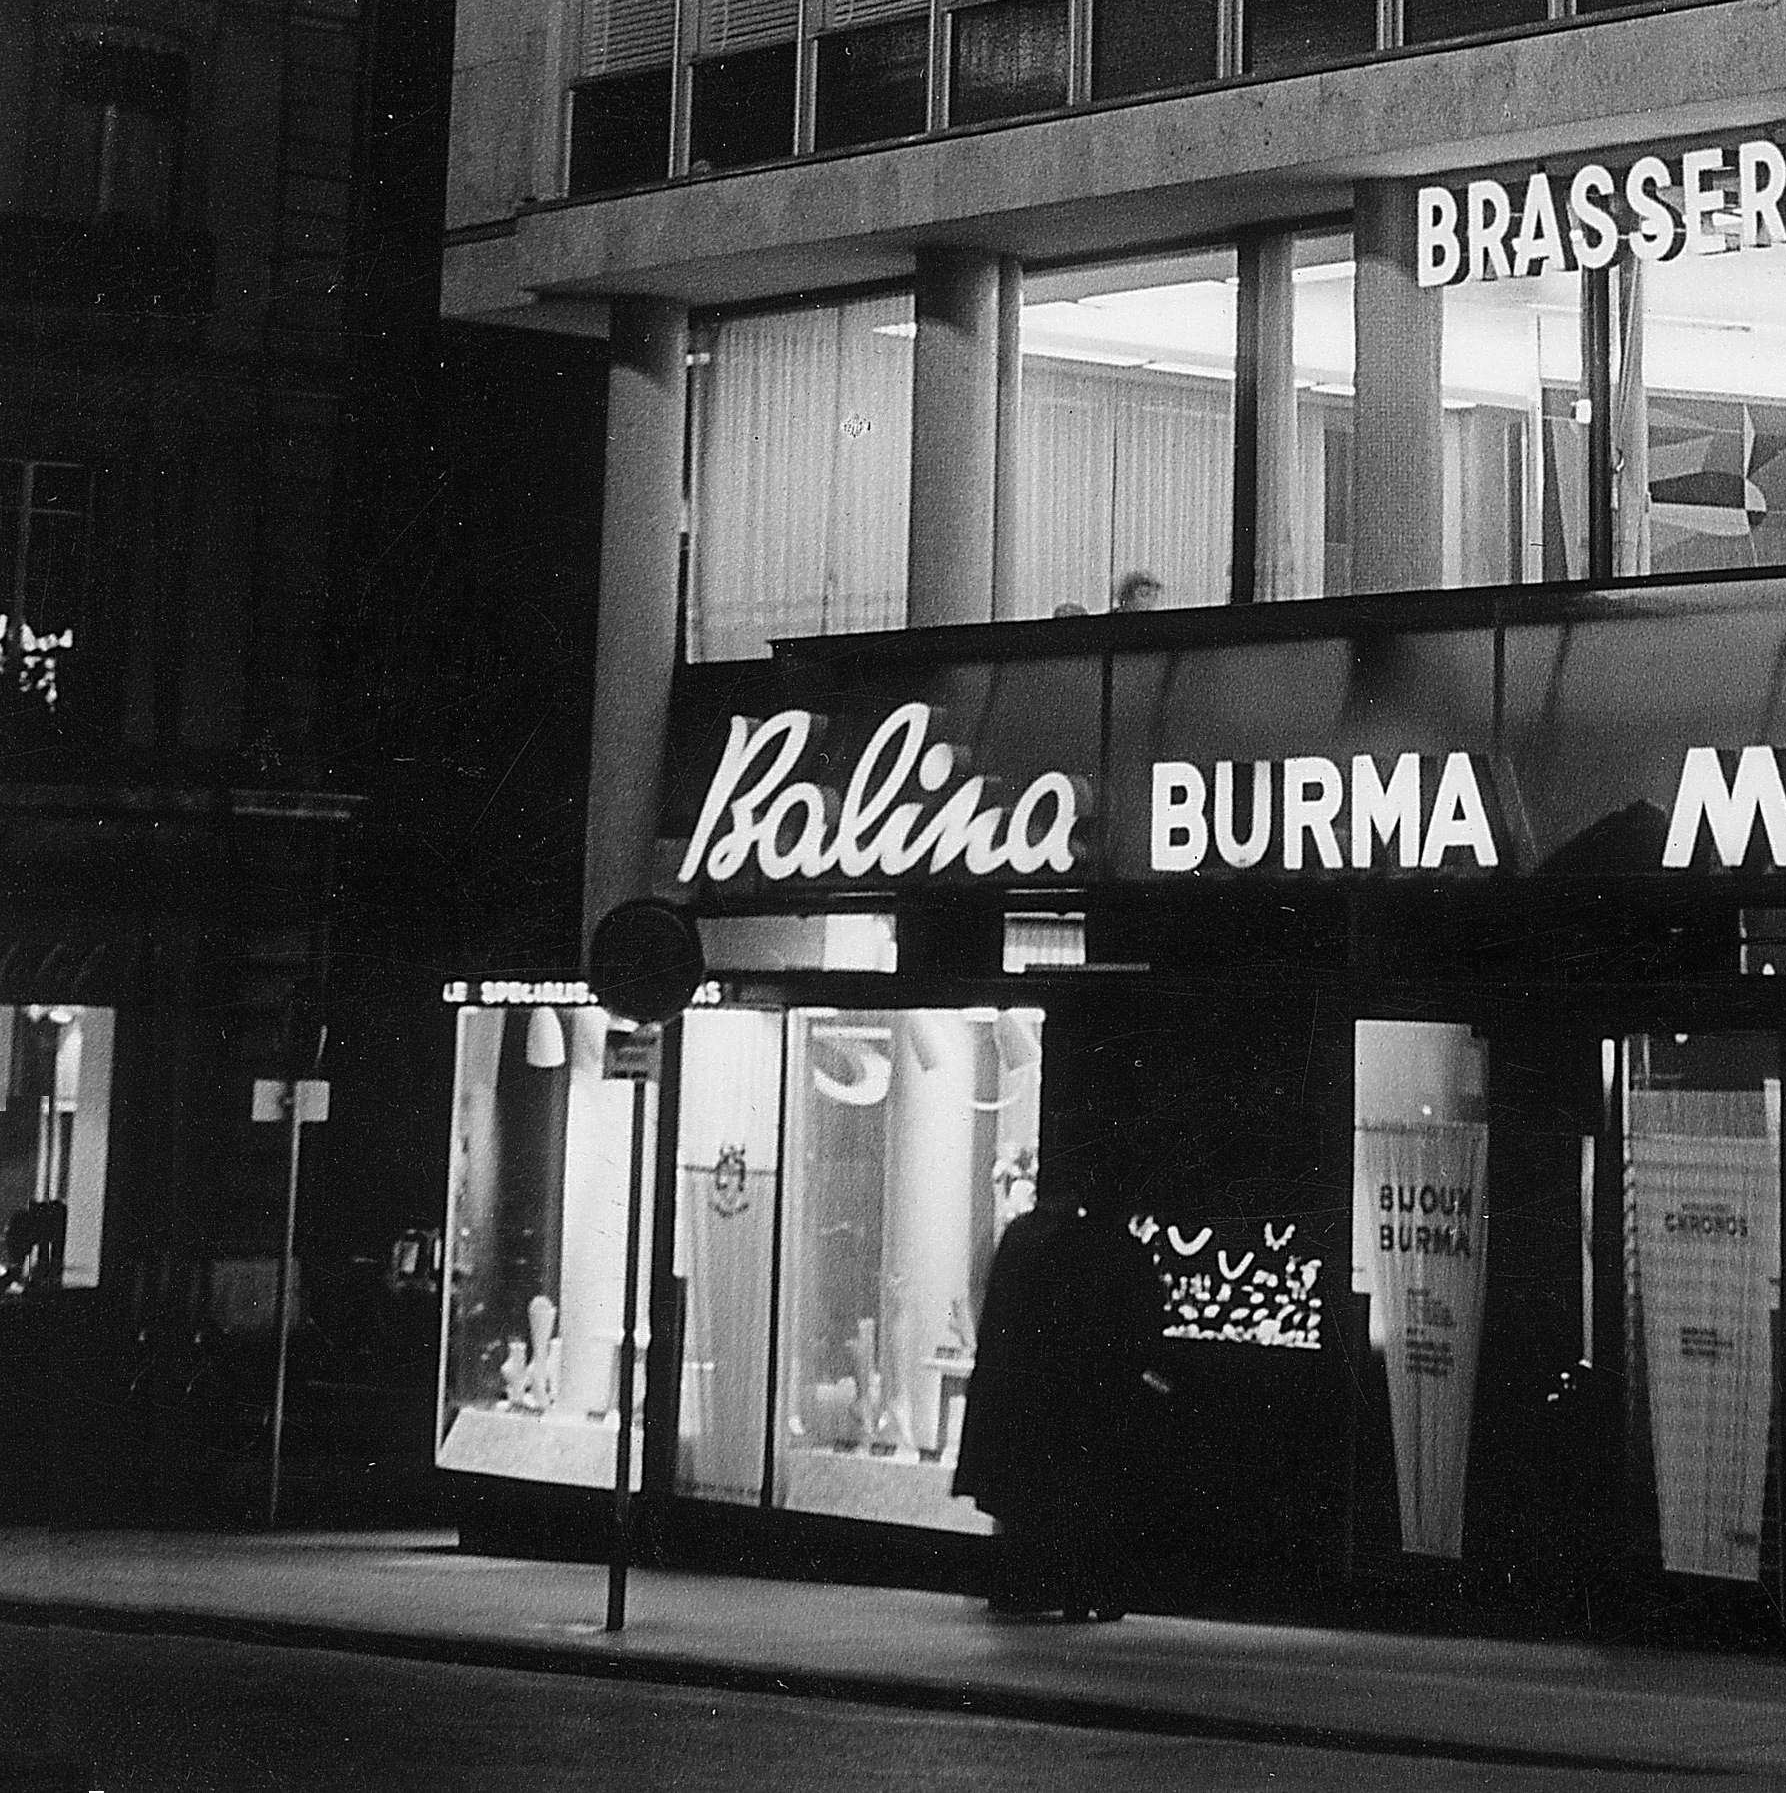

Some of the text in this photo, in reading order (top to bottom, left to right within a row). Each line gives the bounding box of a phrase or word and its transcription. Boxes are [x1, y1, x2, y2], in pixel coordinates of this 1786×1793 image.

[678, 701, 1077, 883] Balina
[1150, 751, 1499, 873] BURMA
[480, 981, 599, 1005] SPECIALIS
[1379, 1223, 1471, 1257] BURMA
